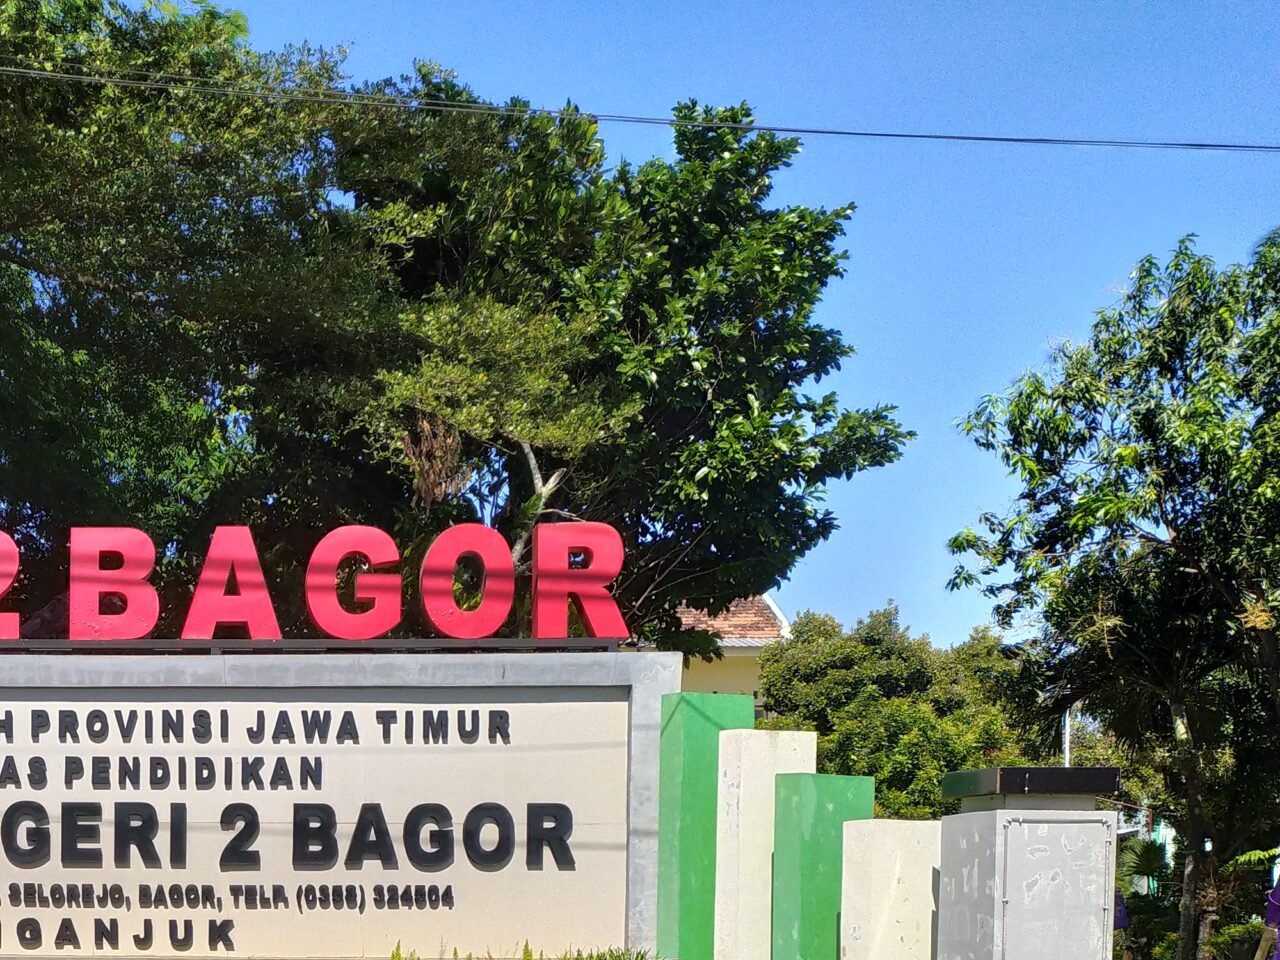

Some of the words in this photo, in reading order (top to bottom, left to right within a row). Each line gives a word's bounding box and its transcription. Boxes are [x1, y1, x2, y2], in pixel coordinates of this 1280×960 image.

[69, 523, 633, 641] BAGOR
[31, 709, 229, 744] PROVINSI
[246, 709, 360, 744] JAWA
[376, 709, 511, 744] TIMUR
[64, 756, 323, 790] PENDIDIKAN
[220, 802, 261, 872] 2
[292, 802, 577, 873] BAGOR
[7, 882, 132, 912] SELOREJO,
[138, 883, 223, 914] BAGOR,
[296, 884, 366, 915] (0358)
